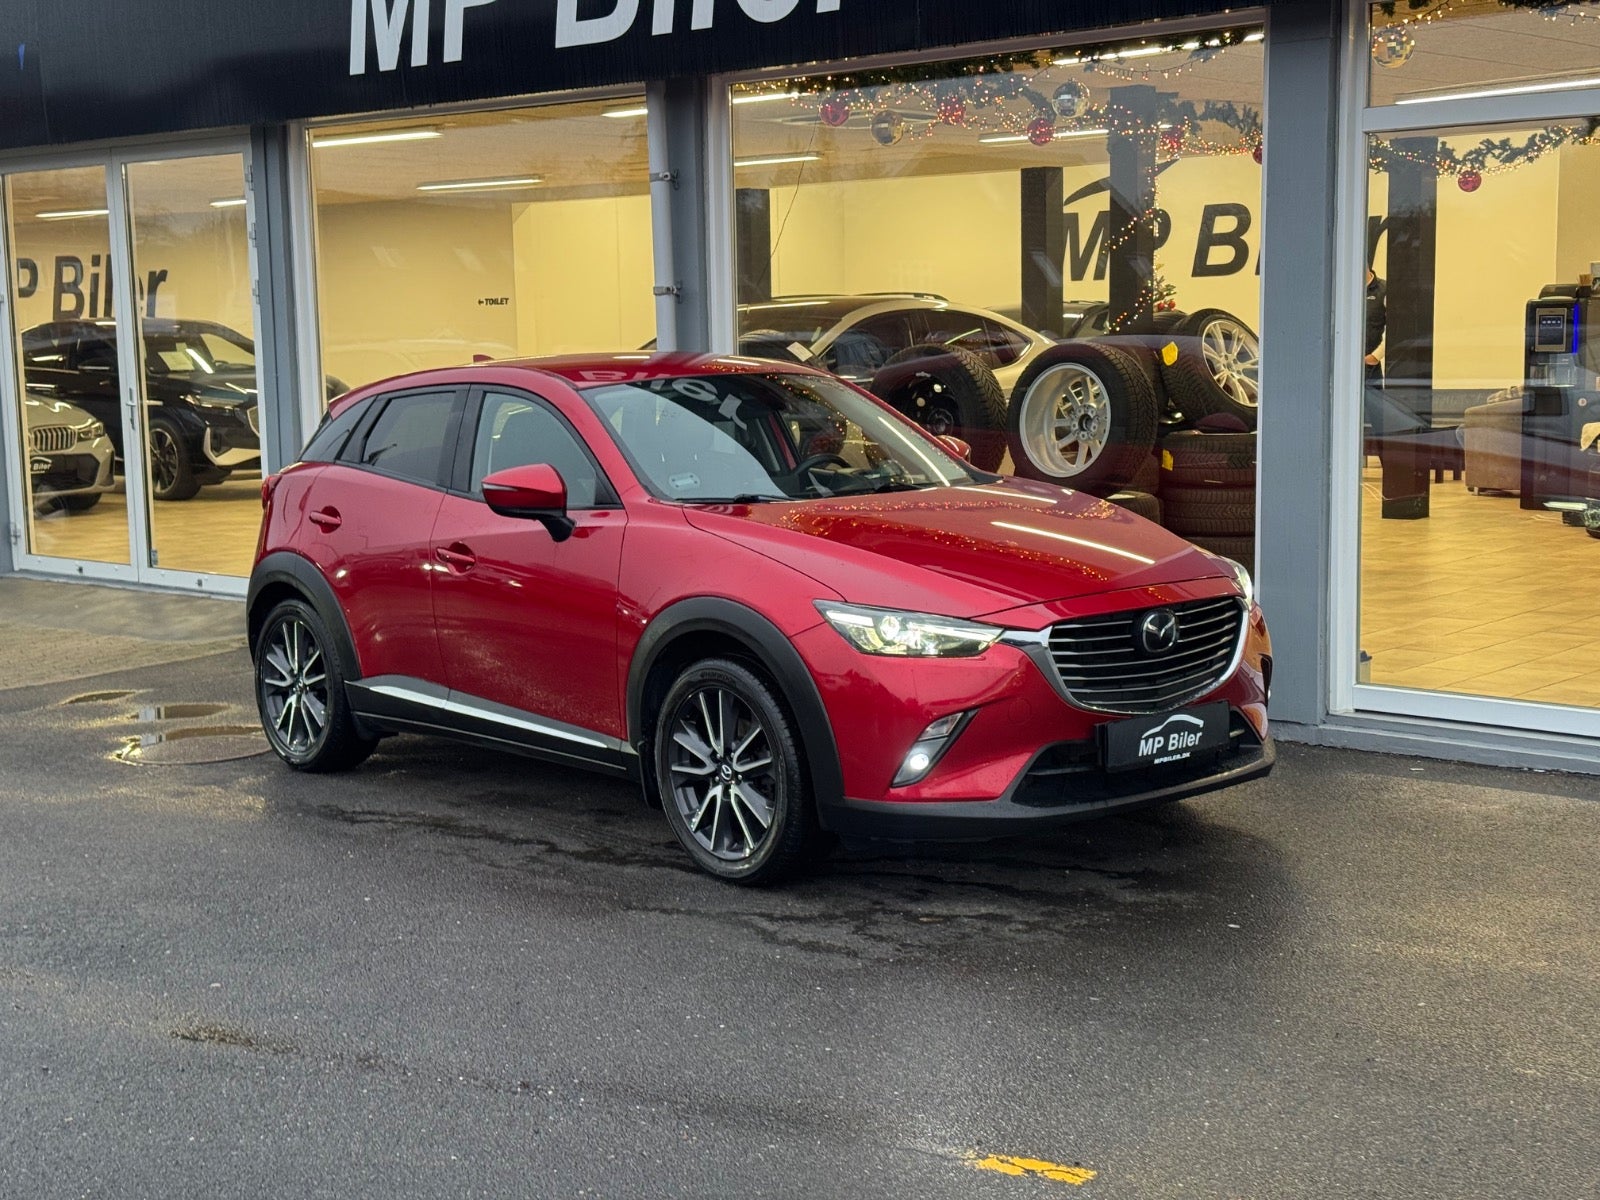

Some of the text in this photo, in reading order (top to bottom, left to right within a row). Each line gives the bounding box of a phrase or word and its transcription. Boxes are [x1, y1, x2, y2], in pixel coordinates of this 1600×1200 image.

[53, 254, 168, 320] Bilr
[484, 297, 510, 306] TOILET
[1139, 731, 1202, 756] MP Biler
